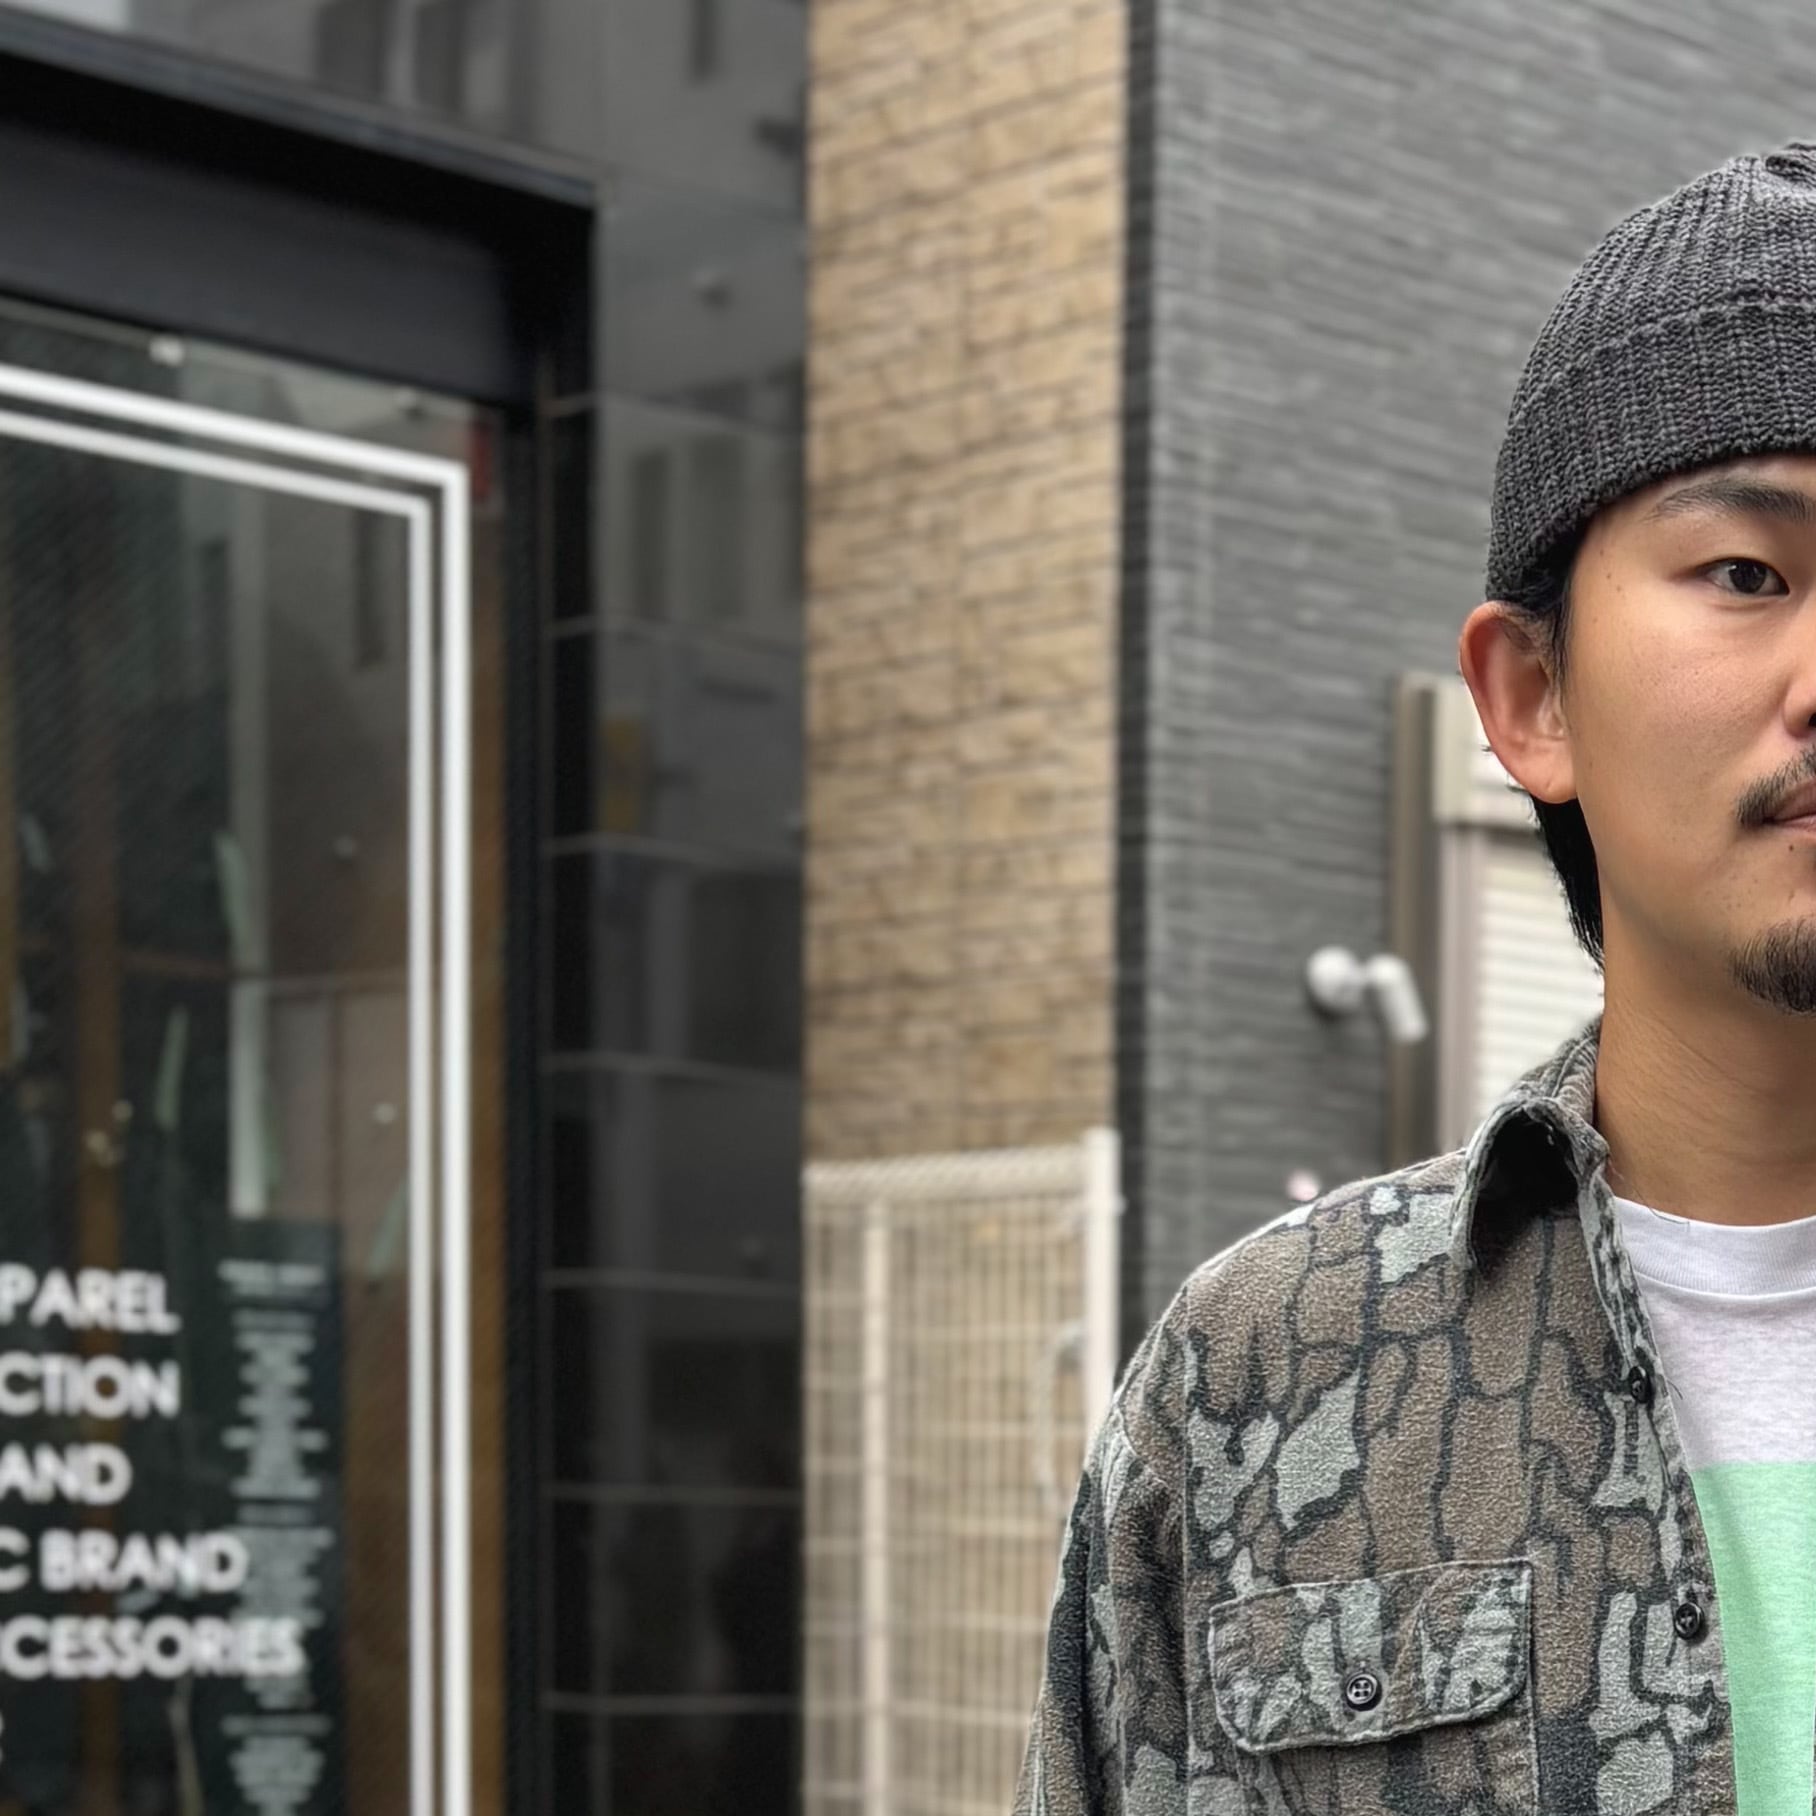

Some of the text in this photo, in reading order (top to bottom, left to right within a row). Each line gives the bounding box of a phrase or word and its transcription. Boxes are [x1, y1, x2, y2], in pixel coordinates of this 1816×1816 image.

[0, 1352, 180, 1418] CTION
[40, 1529, 248, 1595] BRAND
[0, 1616, 304, 1679] CESSORIES
